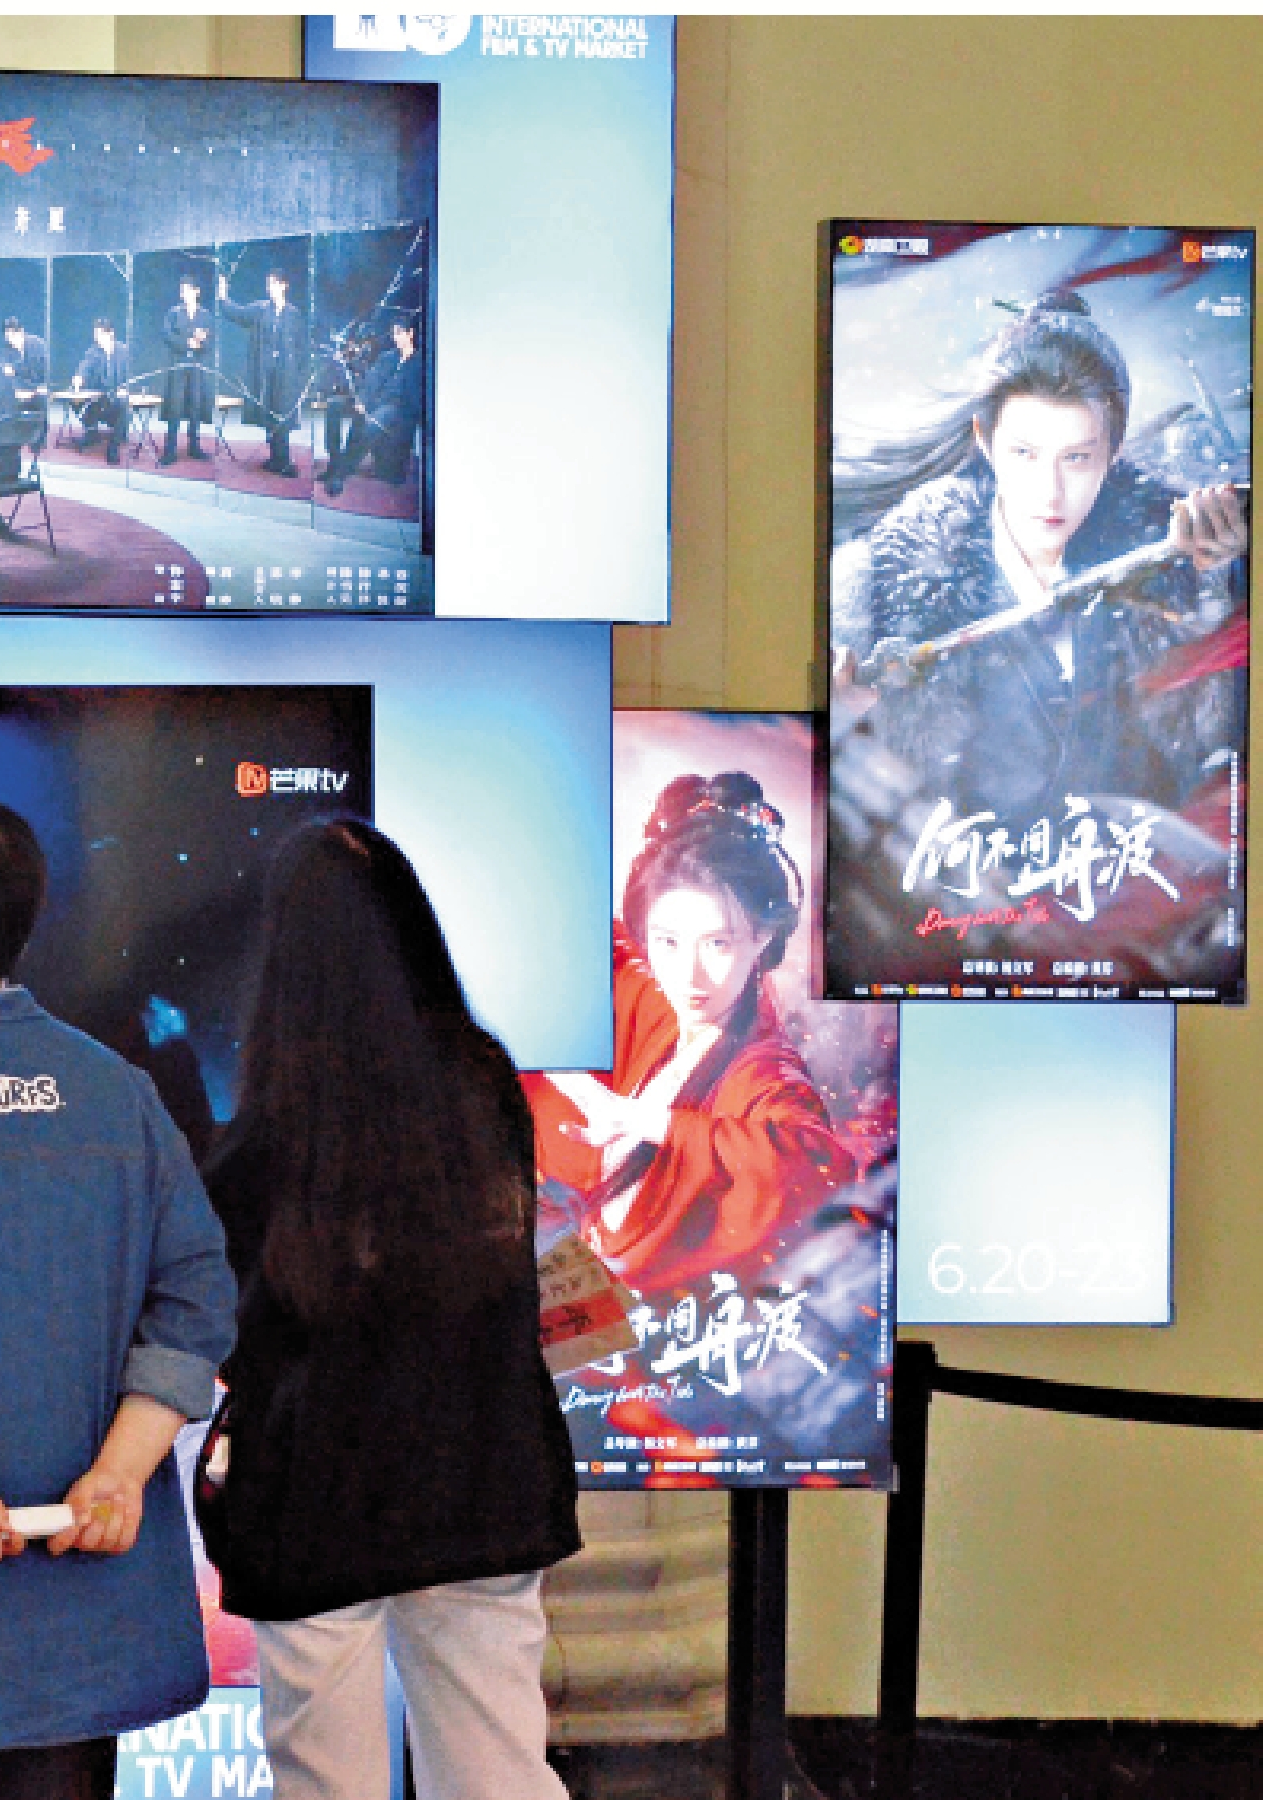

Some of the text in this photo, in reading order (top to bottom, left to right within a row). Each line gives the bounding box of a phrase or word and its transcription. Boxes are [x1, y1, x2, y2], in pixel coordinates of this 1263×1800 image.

[481, 16, 649, 40] INTERNATIONAL
[525, 39, 540, 57] &
[543, 40, 567, 59] TV
[574, 40, 648, 60] MARKET
[589, 1272, 829, 1397] 不同舟渡
[136, 1755, 195, 1799] TV
